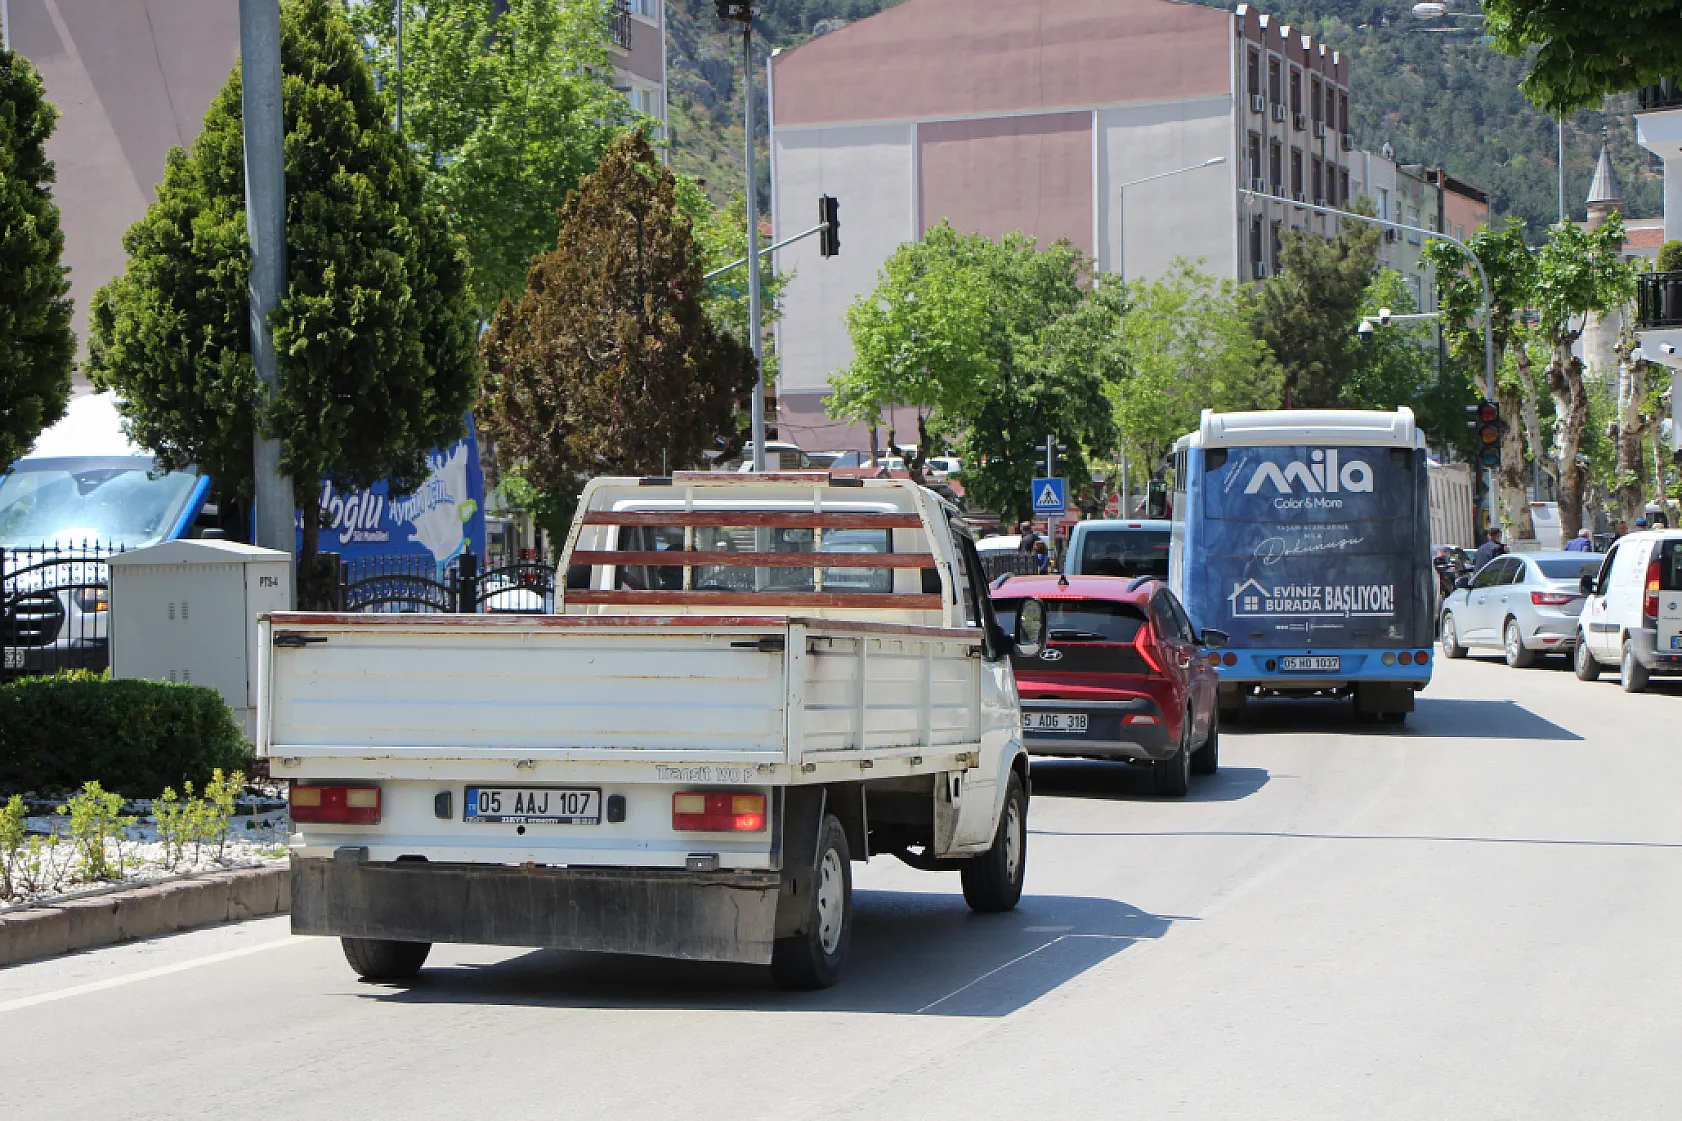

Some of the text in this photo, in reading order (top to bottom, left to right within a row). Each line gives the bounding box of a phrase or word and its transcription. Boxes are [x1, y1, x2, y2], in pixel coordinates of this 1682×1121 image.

[1272, 583, 1322, 598] EVİNİZ
[1266, 584, 1394, 618] BURADA BAŞLIYOR!
[1284, 657, 1297, 669] 05
[1067, 714, 1086, 728] 318
[655, 764, 711, 782] Transit
[480, 791, 591, 815] 05 AAJ 107
